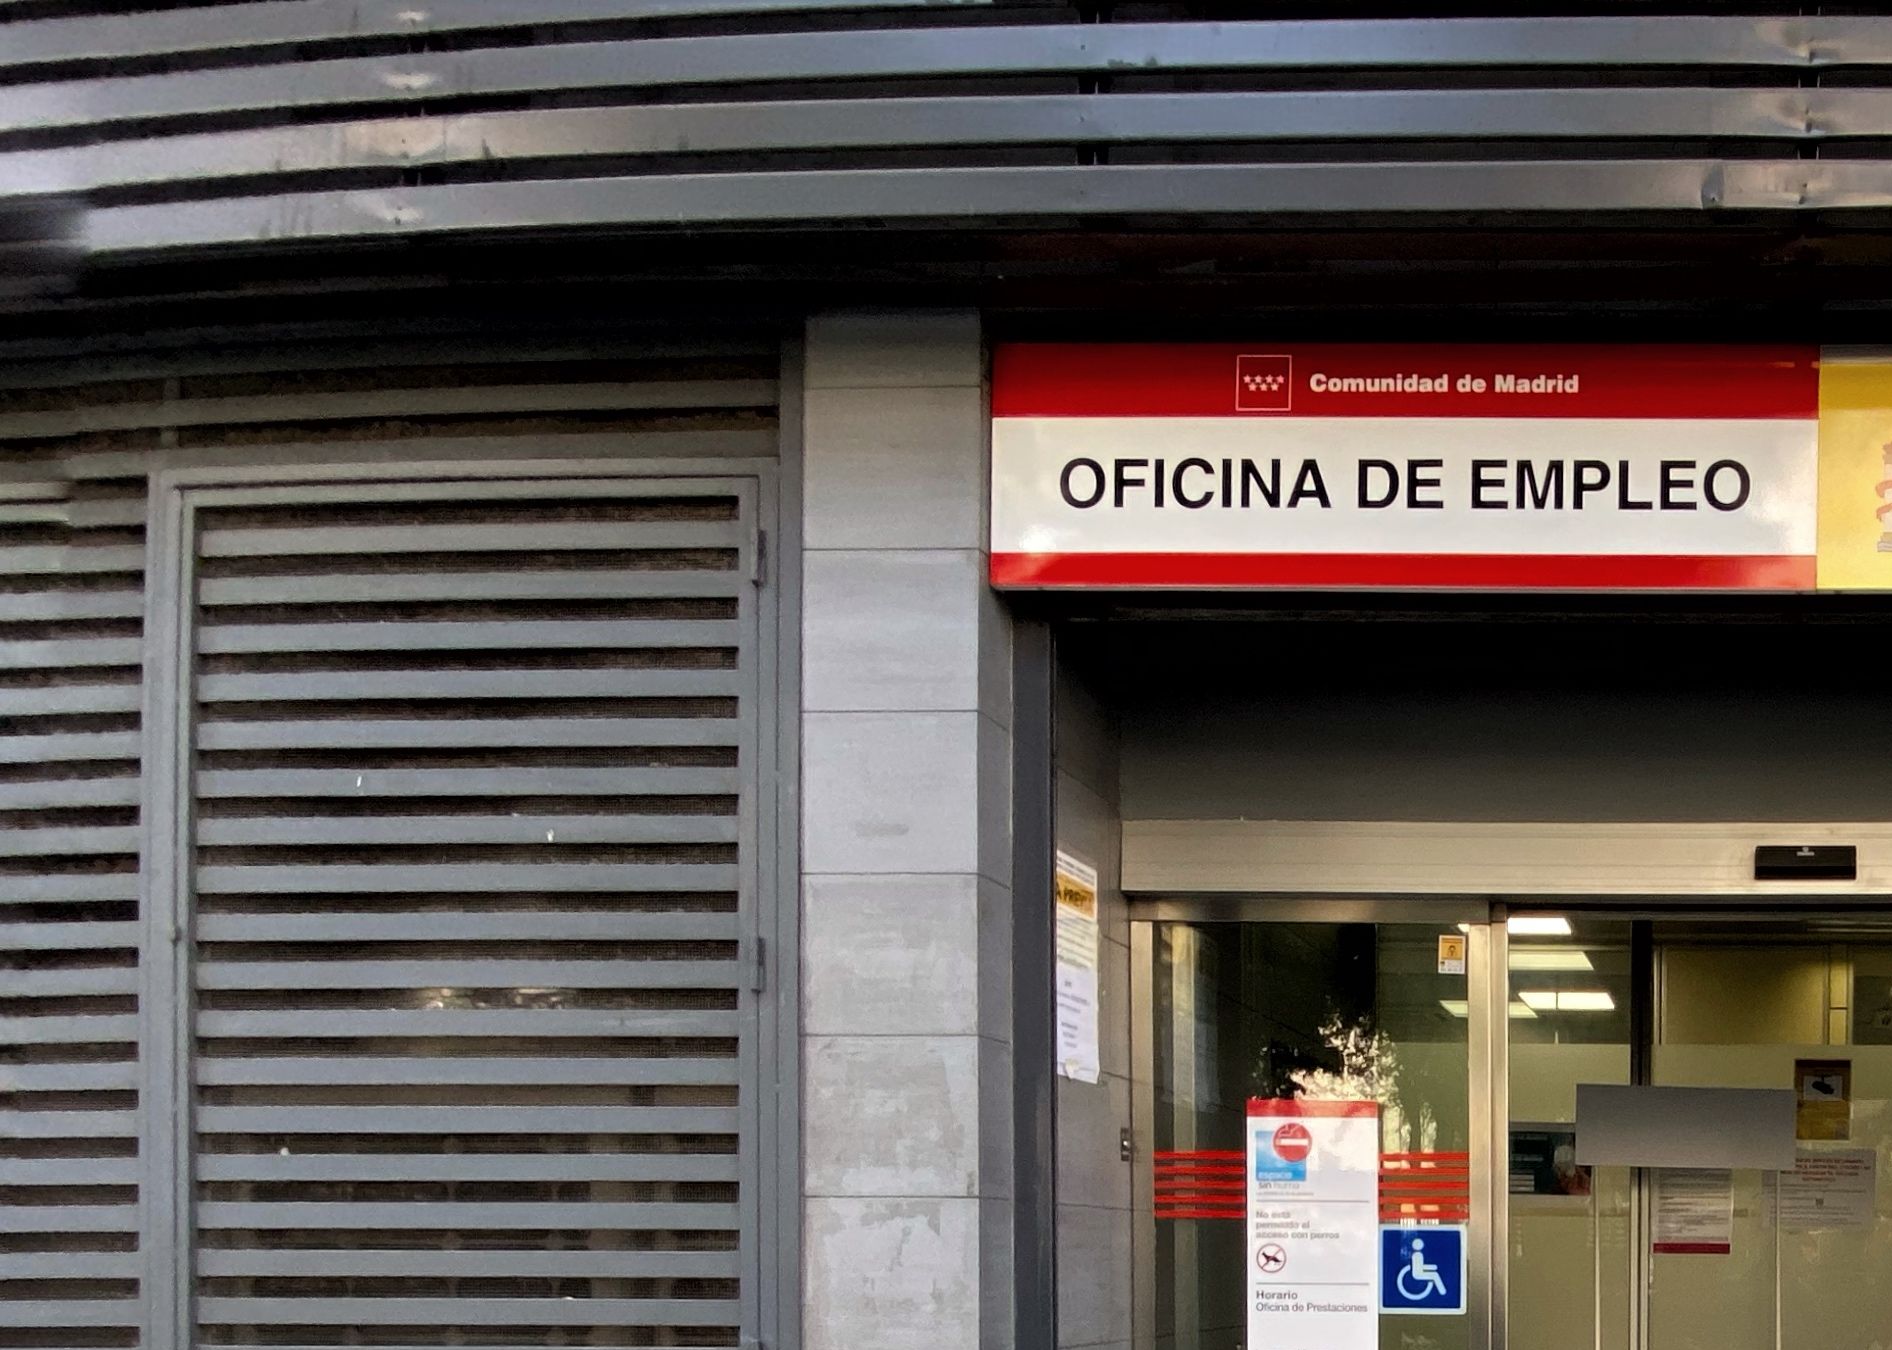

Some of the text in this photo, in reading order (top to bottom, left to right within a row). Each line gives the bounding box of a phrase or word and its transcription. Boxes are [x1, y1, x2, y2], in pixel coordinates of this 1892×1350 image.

[1309, 373, 1579, 394] Comunidad de Madrid
[1059, 457, 1750, 511] OFICINA DE EMPLEO
[1256, 1290, 1298, 1300] Horario
[1256, 1302, 1368, 1313] Oficina de Prestaciones
